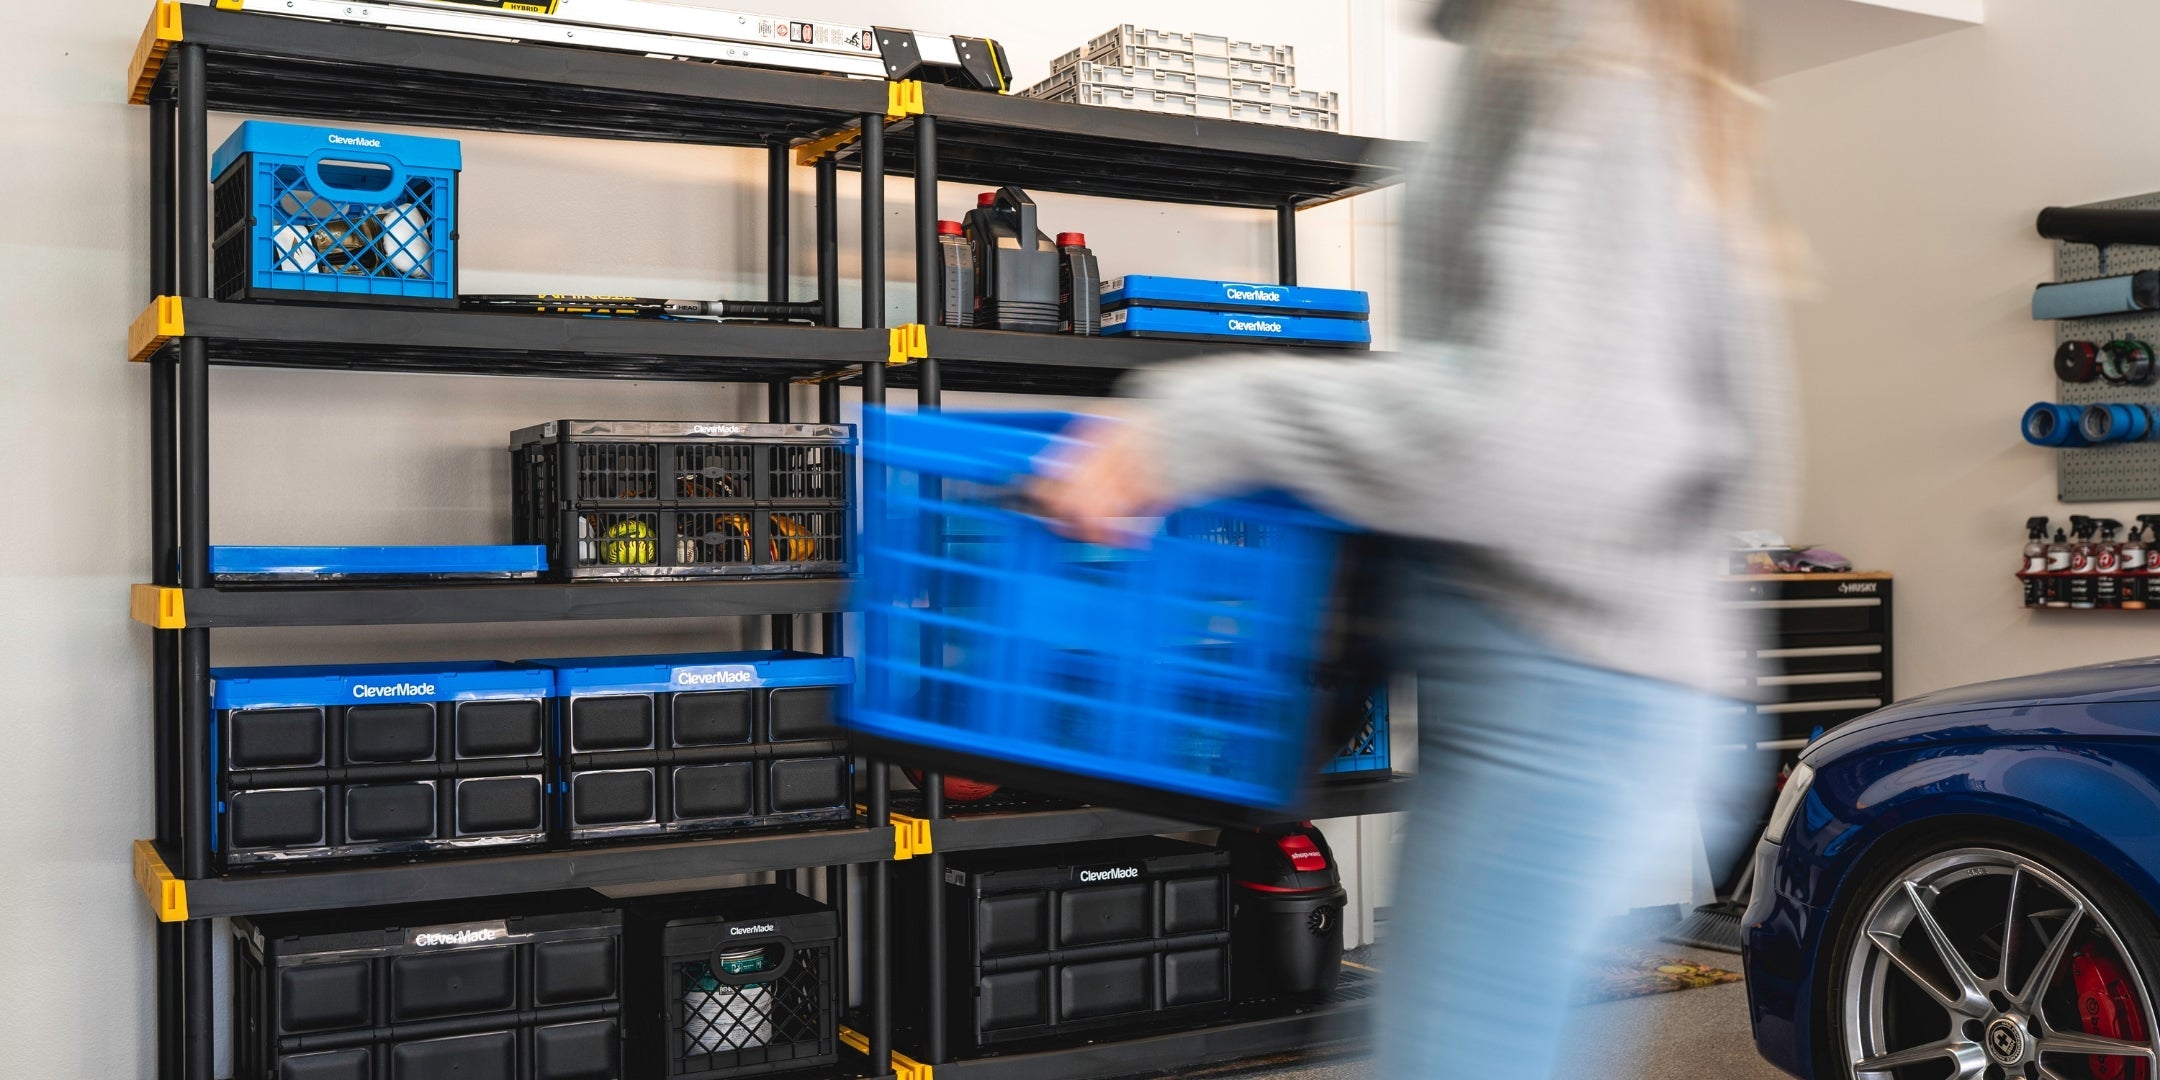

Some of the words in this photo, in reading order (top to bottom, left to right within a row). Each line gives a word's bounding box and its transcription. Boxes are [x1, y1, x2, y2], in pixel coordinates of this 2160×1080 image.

[511, 4, 539, 13] HYBRID
[328, 134, 382, 148] CleverMade
[1226, 288, 1280, 302] CleverMade
[1228, 319, 1282, 333] CleverMade
[693, 424, 740, 433] CleverMade
[1848, 582, 1877, 593] HUSKY
[678, 670, 751, 685] CleverMade
[352, 682, 436, 699] CleverMade
[1081, 867, 1139, 882] CleverMade
[730, 924, 774, 936] CleverMade
[415, 928, 497, 947] CleverMade
